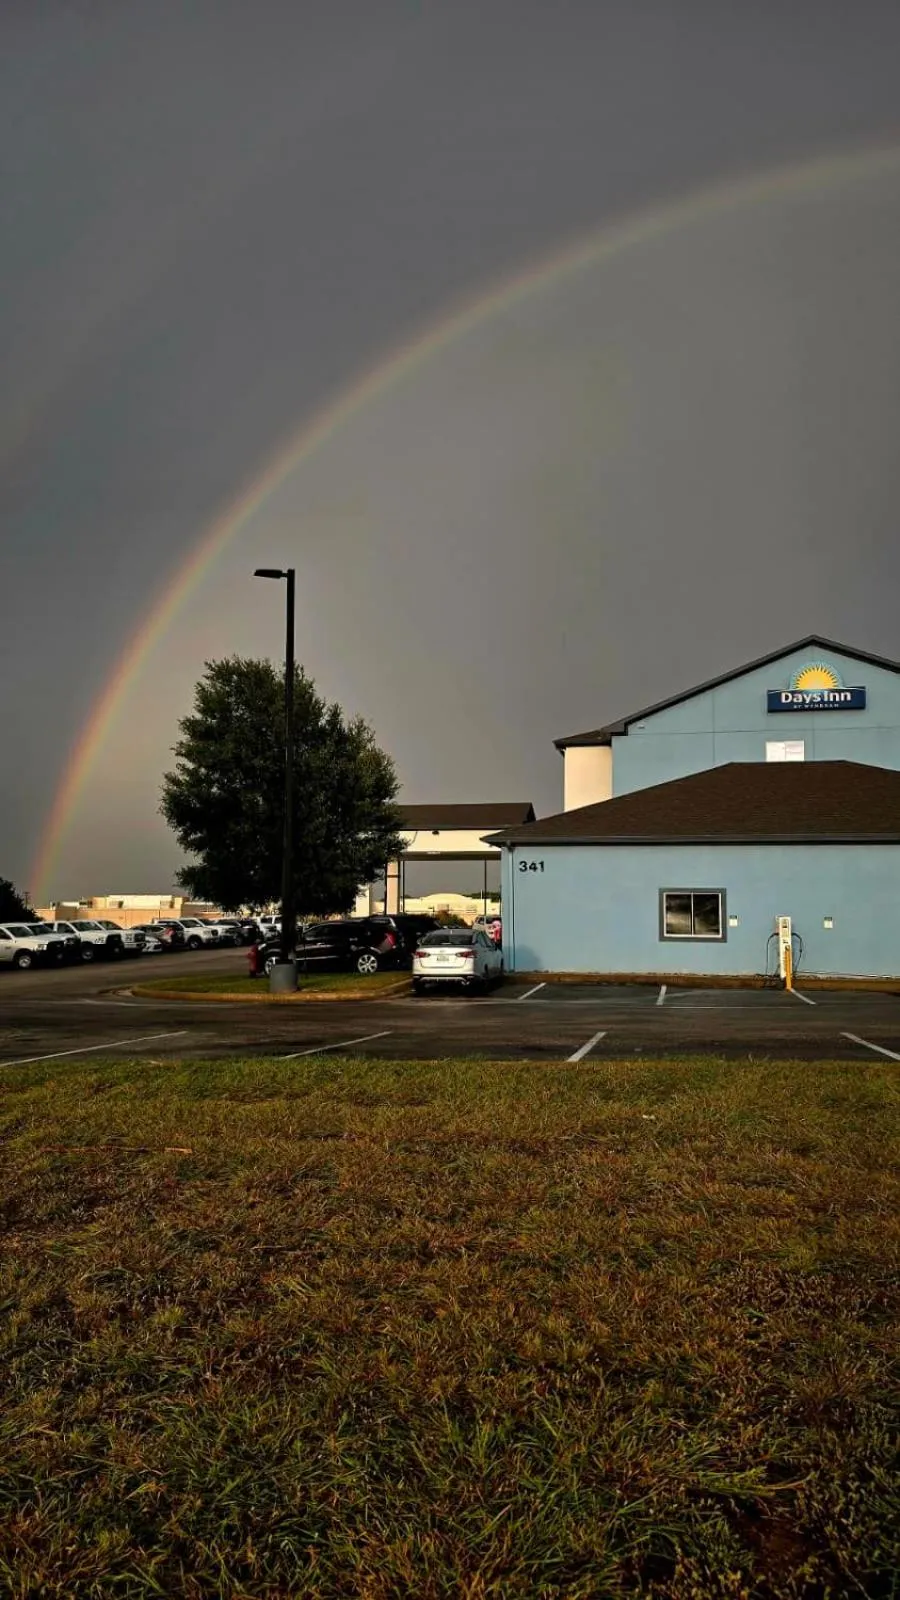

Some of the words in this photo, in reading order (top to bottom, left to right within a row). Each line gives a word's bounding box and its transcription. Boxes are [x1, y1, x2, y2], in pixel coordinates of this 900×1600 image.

[781, 692, 821, 704] Days
[824, 690, 851, 702] Inn
[519, 860, 545, 873] 341
